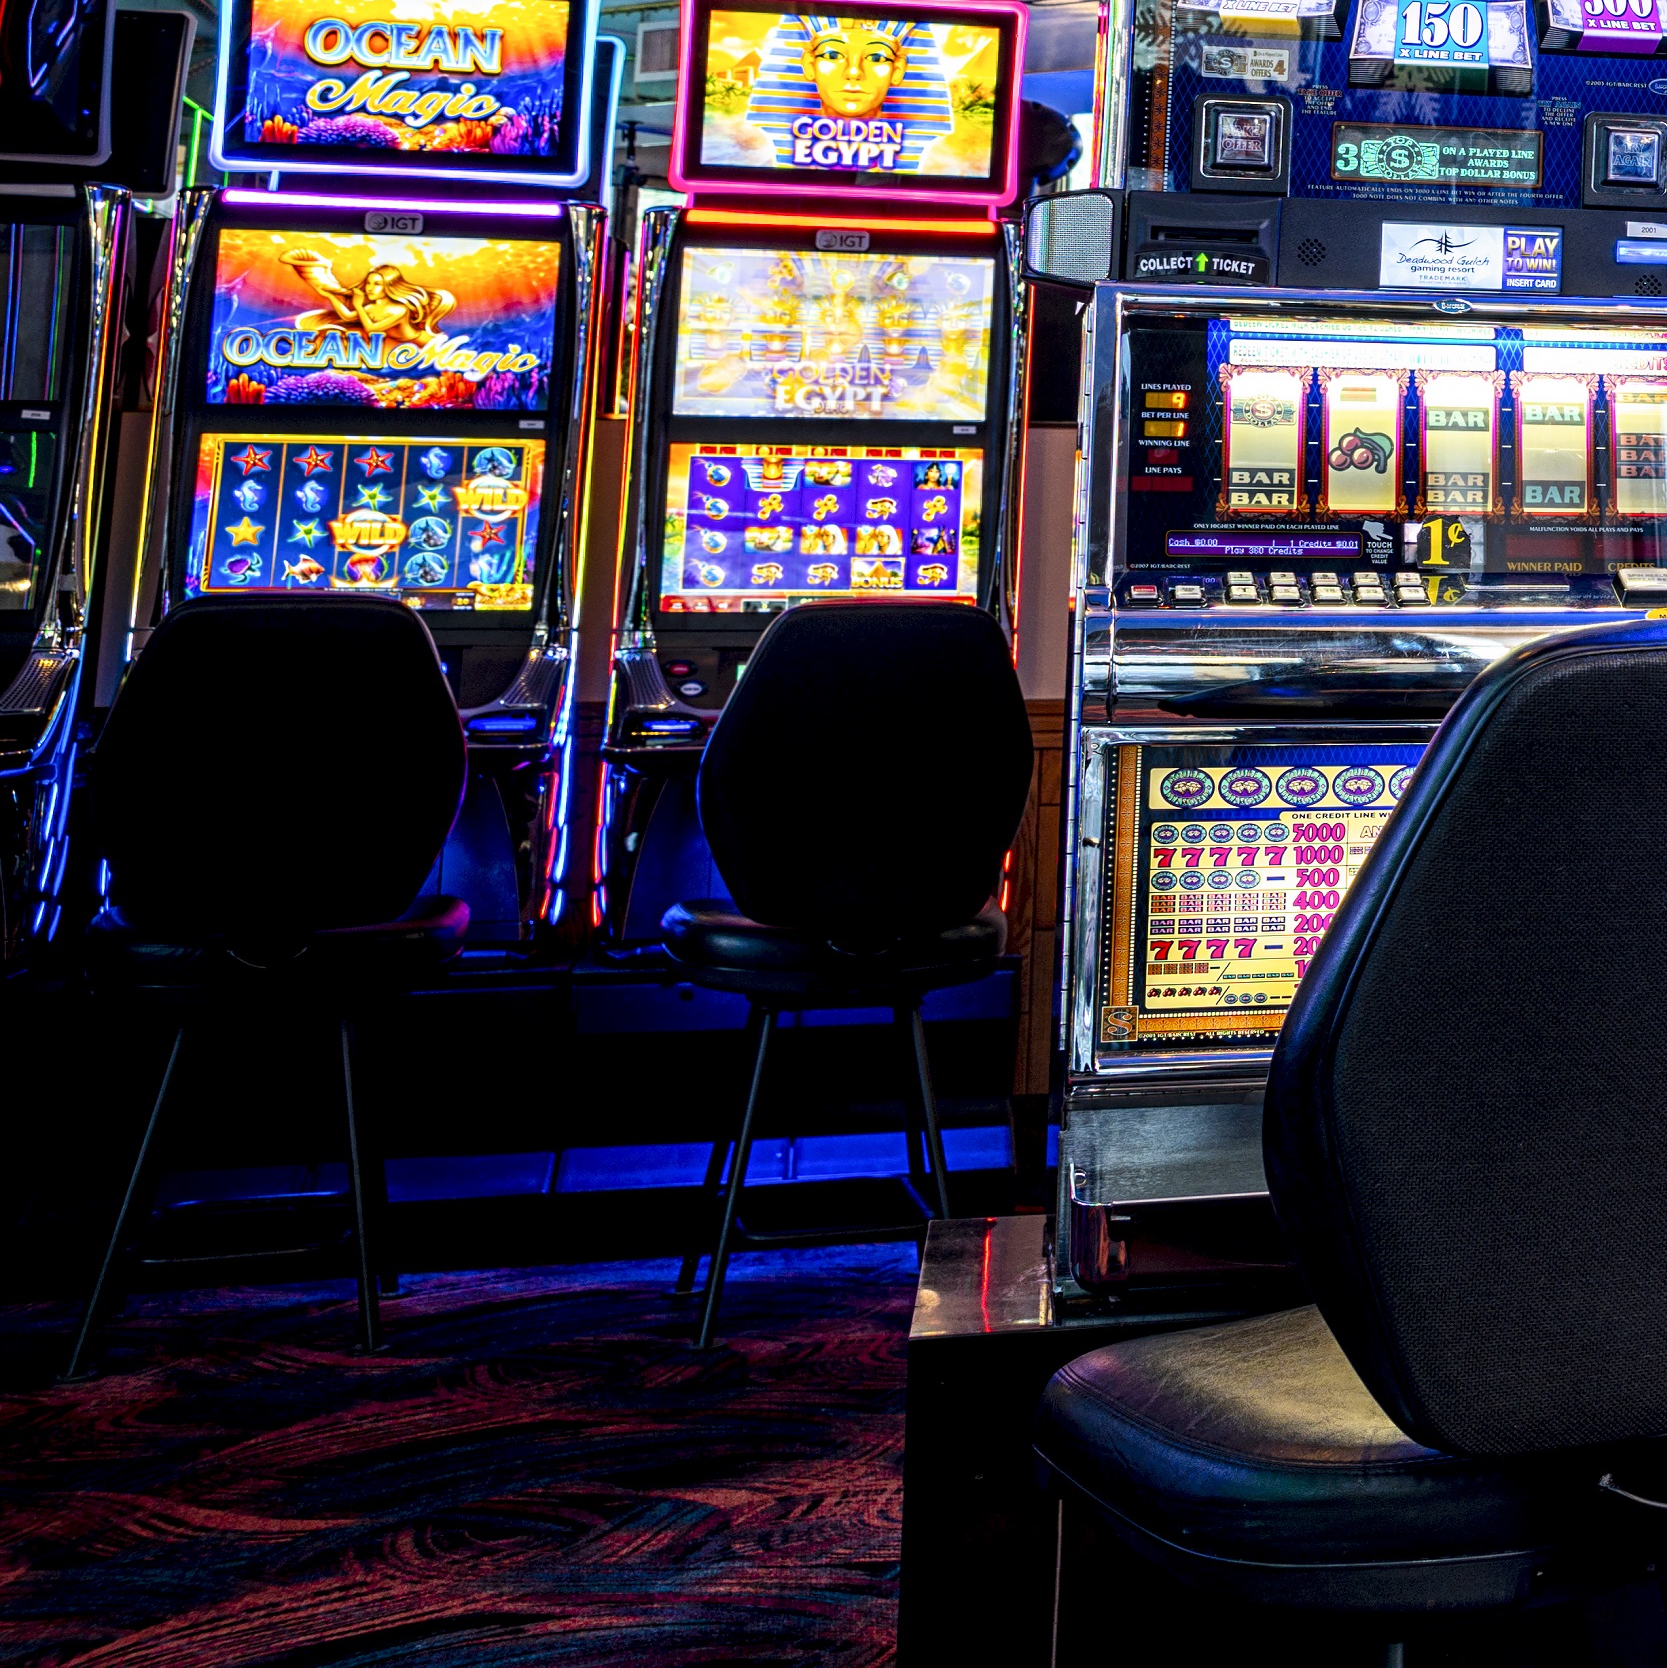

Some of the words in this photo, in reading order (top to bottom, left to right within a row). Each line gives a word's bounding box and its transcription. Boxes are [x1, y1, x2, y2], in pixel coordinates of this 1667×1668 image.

[1401, 0, 1484, 49] 150
[1586, 19, 1598, 28] X
[1599, 19, 1629, 30] LINE
[1631, 21, 1656, 31] BET
[305, 18, 502, 74] OCEAN
[1250, 59, 1274, 69] AWARDS
[1273, 60, 1287, 76] 4
[1251, 68, 1272, 78] OFFERS
[306, 70, 502, 128] Magic
[791, 116, 904, 144] GOLDEN
[791, 140, 902, 170] EGYPT
[1336, 143, 1358, 171] 3
[1442, 146, 1456, 158] ON
[1458, 148, 1466, 158] A
[1468, 147, 1508, 160] PLAYED
[1511, 150, 1534, 160] LINE
[1468, 158, 1509, 169] AWARDS
[1439, 168, 1456, 178] TOP
[1458, 168, 1500, 180] DOLLAR
[1502, 170, 1536, 181] BONUS
[389, 214, 421, 232] IGT
[1641, 226, 1657, 234] 2001
[1506, 236, 1559, 258] PLAY
[1140, 255, 1194, 272] COLLECT
[1212, 258, 1256, 276] TICKET
[1397, 252, 1454, 267] Deadwood
[1457, 254, 1491, 267] Gulch
[1506, 258, 1524, 272] TO
[1526, 258, 1557, 273] WIN!
[1410, 264, 1443, 276] gaming
[1445, 265, 1475, 274] resort
[1506, 278, 1534, 289] INSERT
[1535, 278, 1557, 289] CARD
[222, 326, 385, 371] OCEAN
[385, 333, 541, 382] Magic
[1161, 384, 1192, 392] PLAYED
[1427, 410, 1486, 429] BAR
[1138, 440, 1172, 448] WINNING
[1174, 440, 1190, 448] LINE
[1232, 471, 1291, 485] BAR
[1526, 485, 1581, 504] BAR
[328, 517, 408, 550] WILD
[1506, 561, 1552, 572] WINNER
[1554, 561, 1582, 572] PAID
[850, 573, 905, 591] BONUS
[1315, 812, 1351, 820] CREDIT
[1292, 822, 1346, 843] 5000
[1294, 844, 1345, 866] 1000
[1292, 890, 1341, 911] 400
